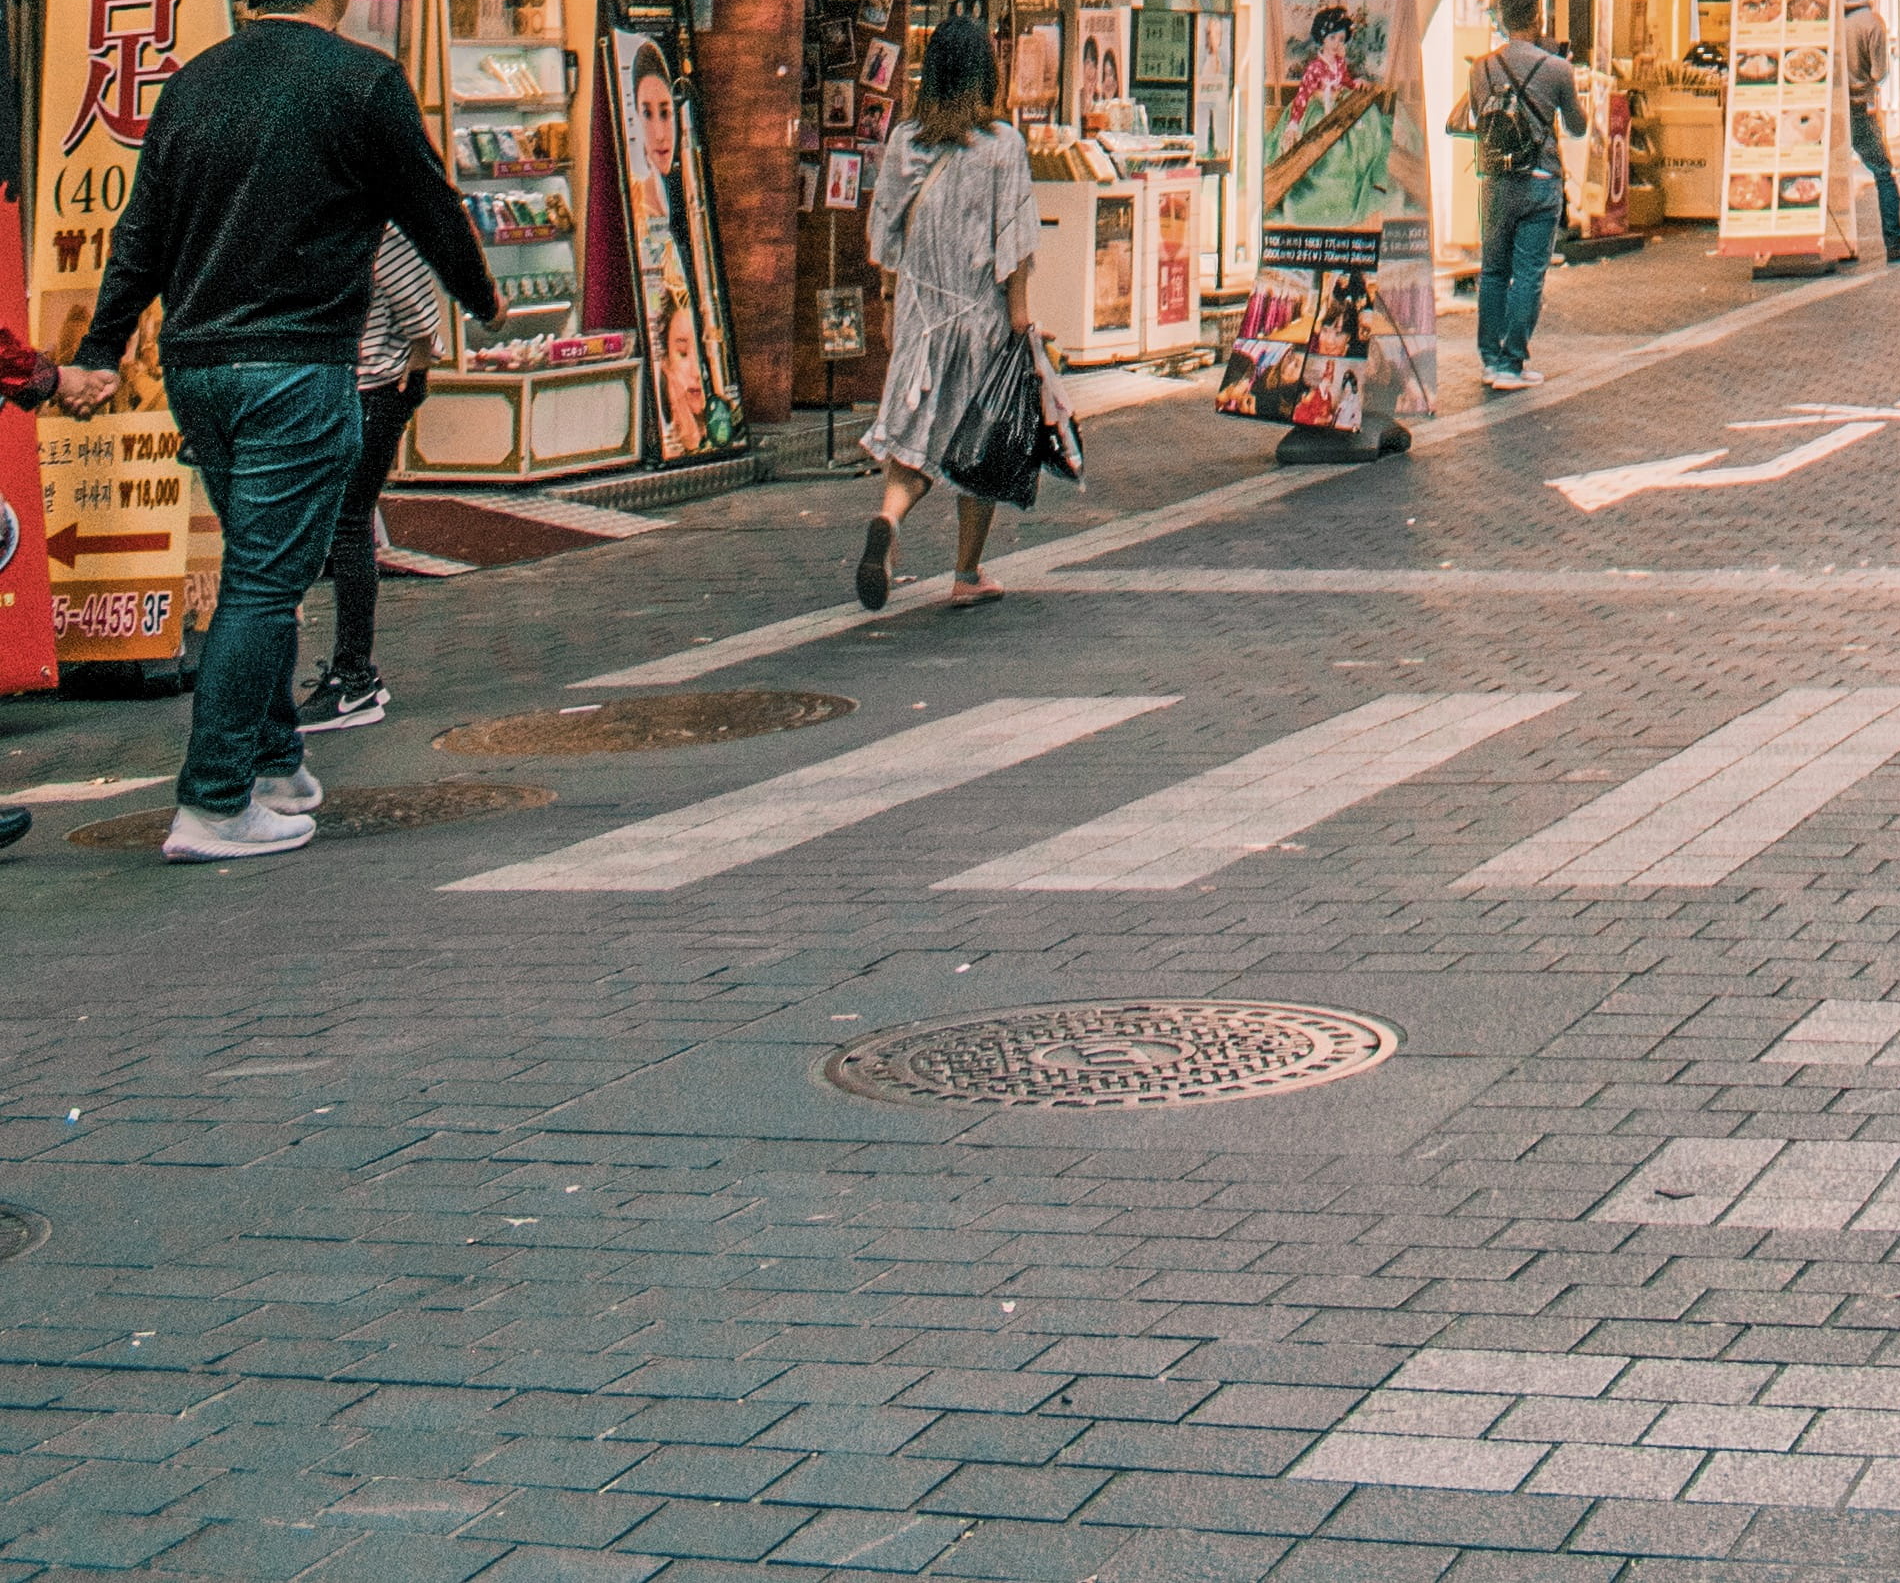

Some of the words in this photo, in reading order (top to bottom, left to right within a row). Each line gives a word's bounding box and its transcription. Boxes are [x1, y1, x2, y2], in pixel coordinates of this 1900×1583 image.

[119, 478, 181, 510] ₩18,000
[52, 592, 137, 637] 5-4455
[142, 591, 171, 635] 3F
